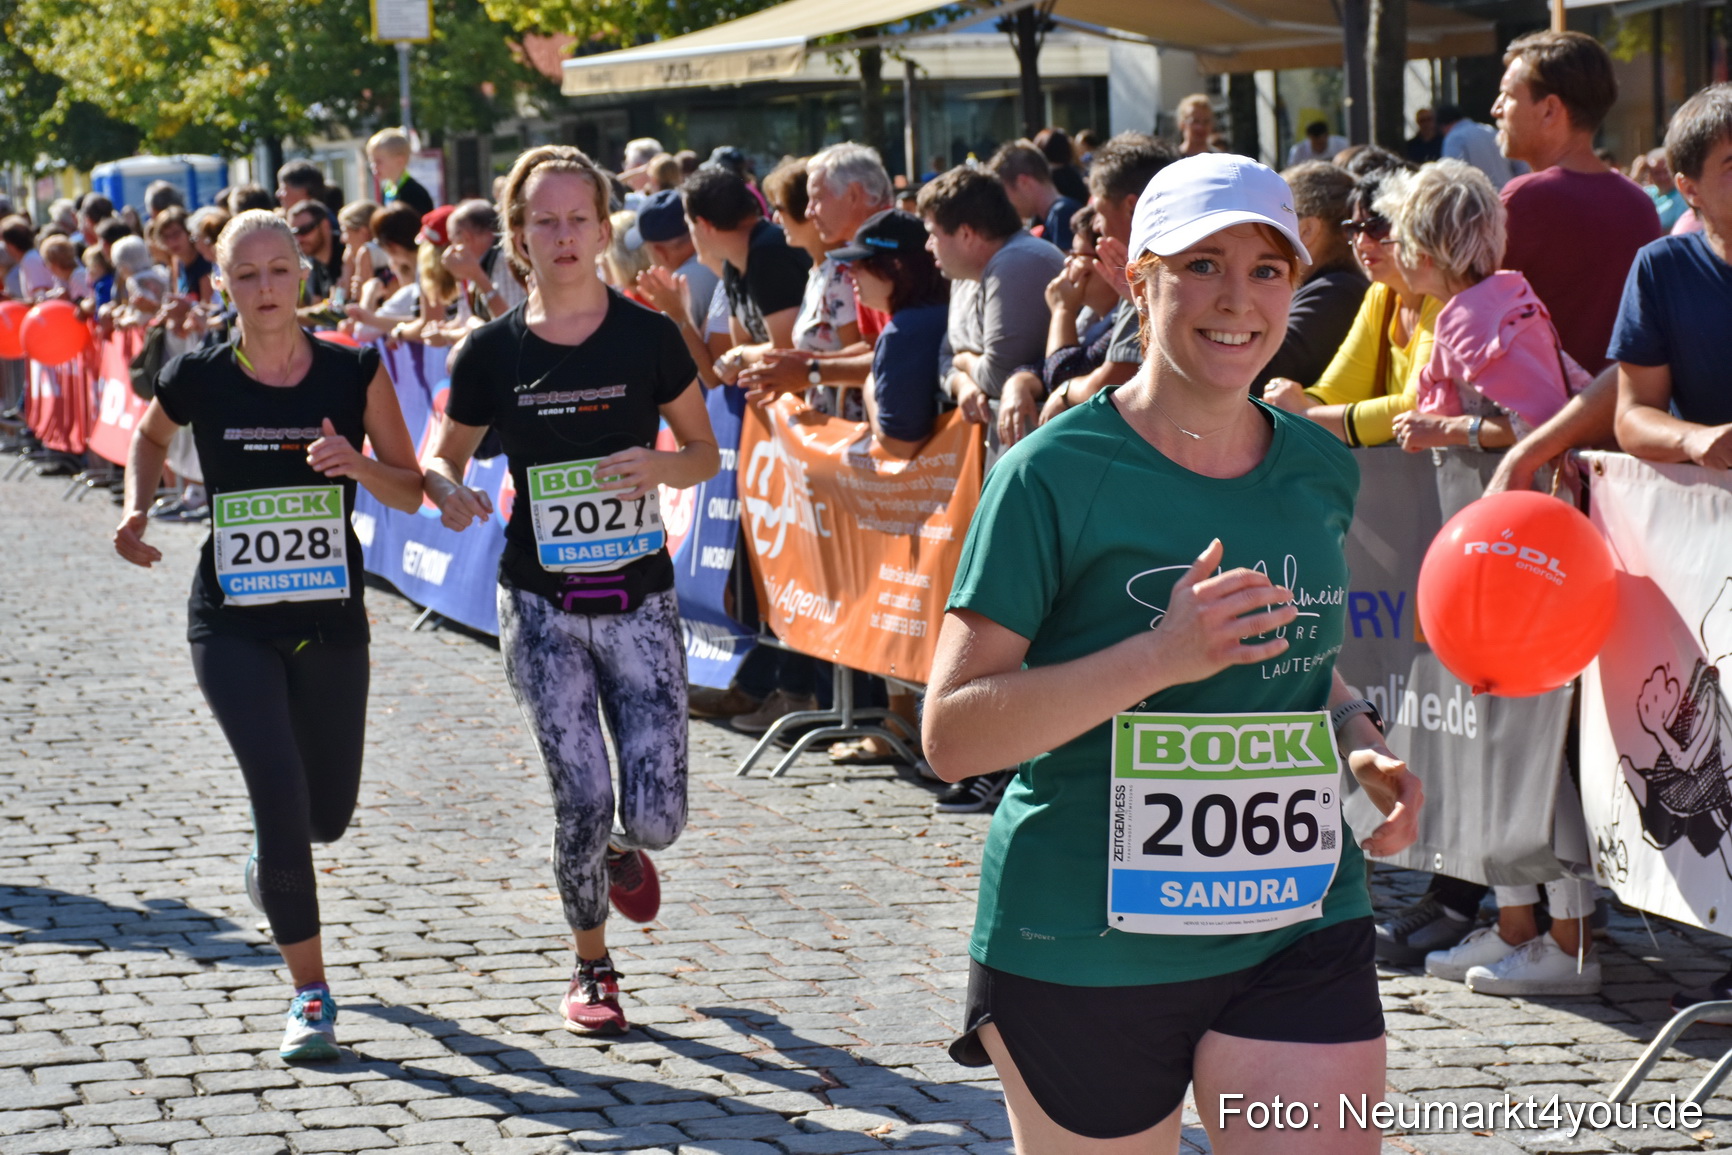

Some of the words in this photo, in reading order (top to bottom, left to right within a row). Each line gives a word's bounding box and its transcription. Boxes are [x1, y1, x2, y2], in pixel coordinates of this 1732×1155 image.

[225, 492, 331, 522] BOCK
[549, 495, 646, 538] 2027
[230, 527, 331, 566] 2028
[558, 538, 649, 561] ISABELLE
[1464, 528, 1567, 578] RÖDL
[230, 571, 336, 592] CHRISTINA
[1515, 561, 1563, 586] energie
[1134, 723, 1322, 771] BOCK
[1142, 789, 1319, 857] 2066
[1322, 793, 1331, 805] D
[1159, 877, 1299, 908] SANDRA
